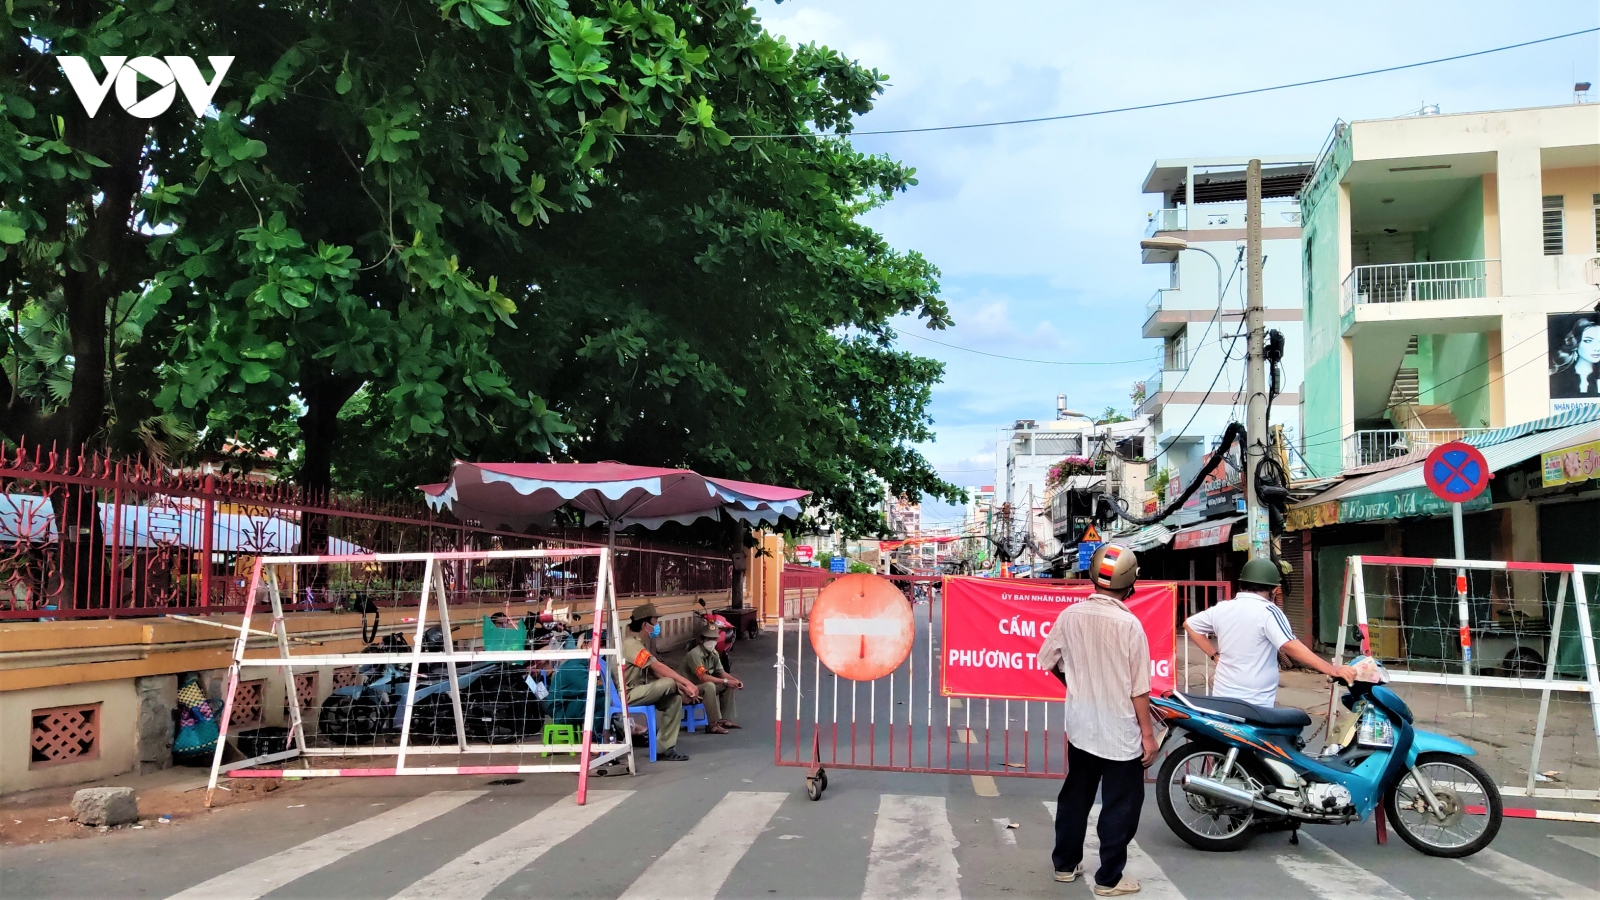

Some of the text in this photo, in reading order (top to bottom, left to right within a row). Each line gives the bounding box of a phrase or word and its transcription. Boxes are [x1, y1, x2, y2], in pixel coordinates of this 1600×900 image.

[1349, 500, 1390, 519] Flowers
[1002, 592, 1012, 600] ỦY
[1031, 594, 1054, 602] NHÂN
[1055, 595, 1072, 603] DÂN
[998, 614, 1036, 638] CẤM
[949, 648, 1023, 669] PHƯƠNG
